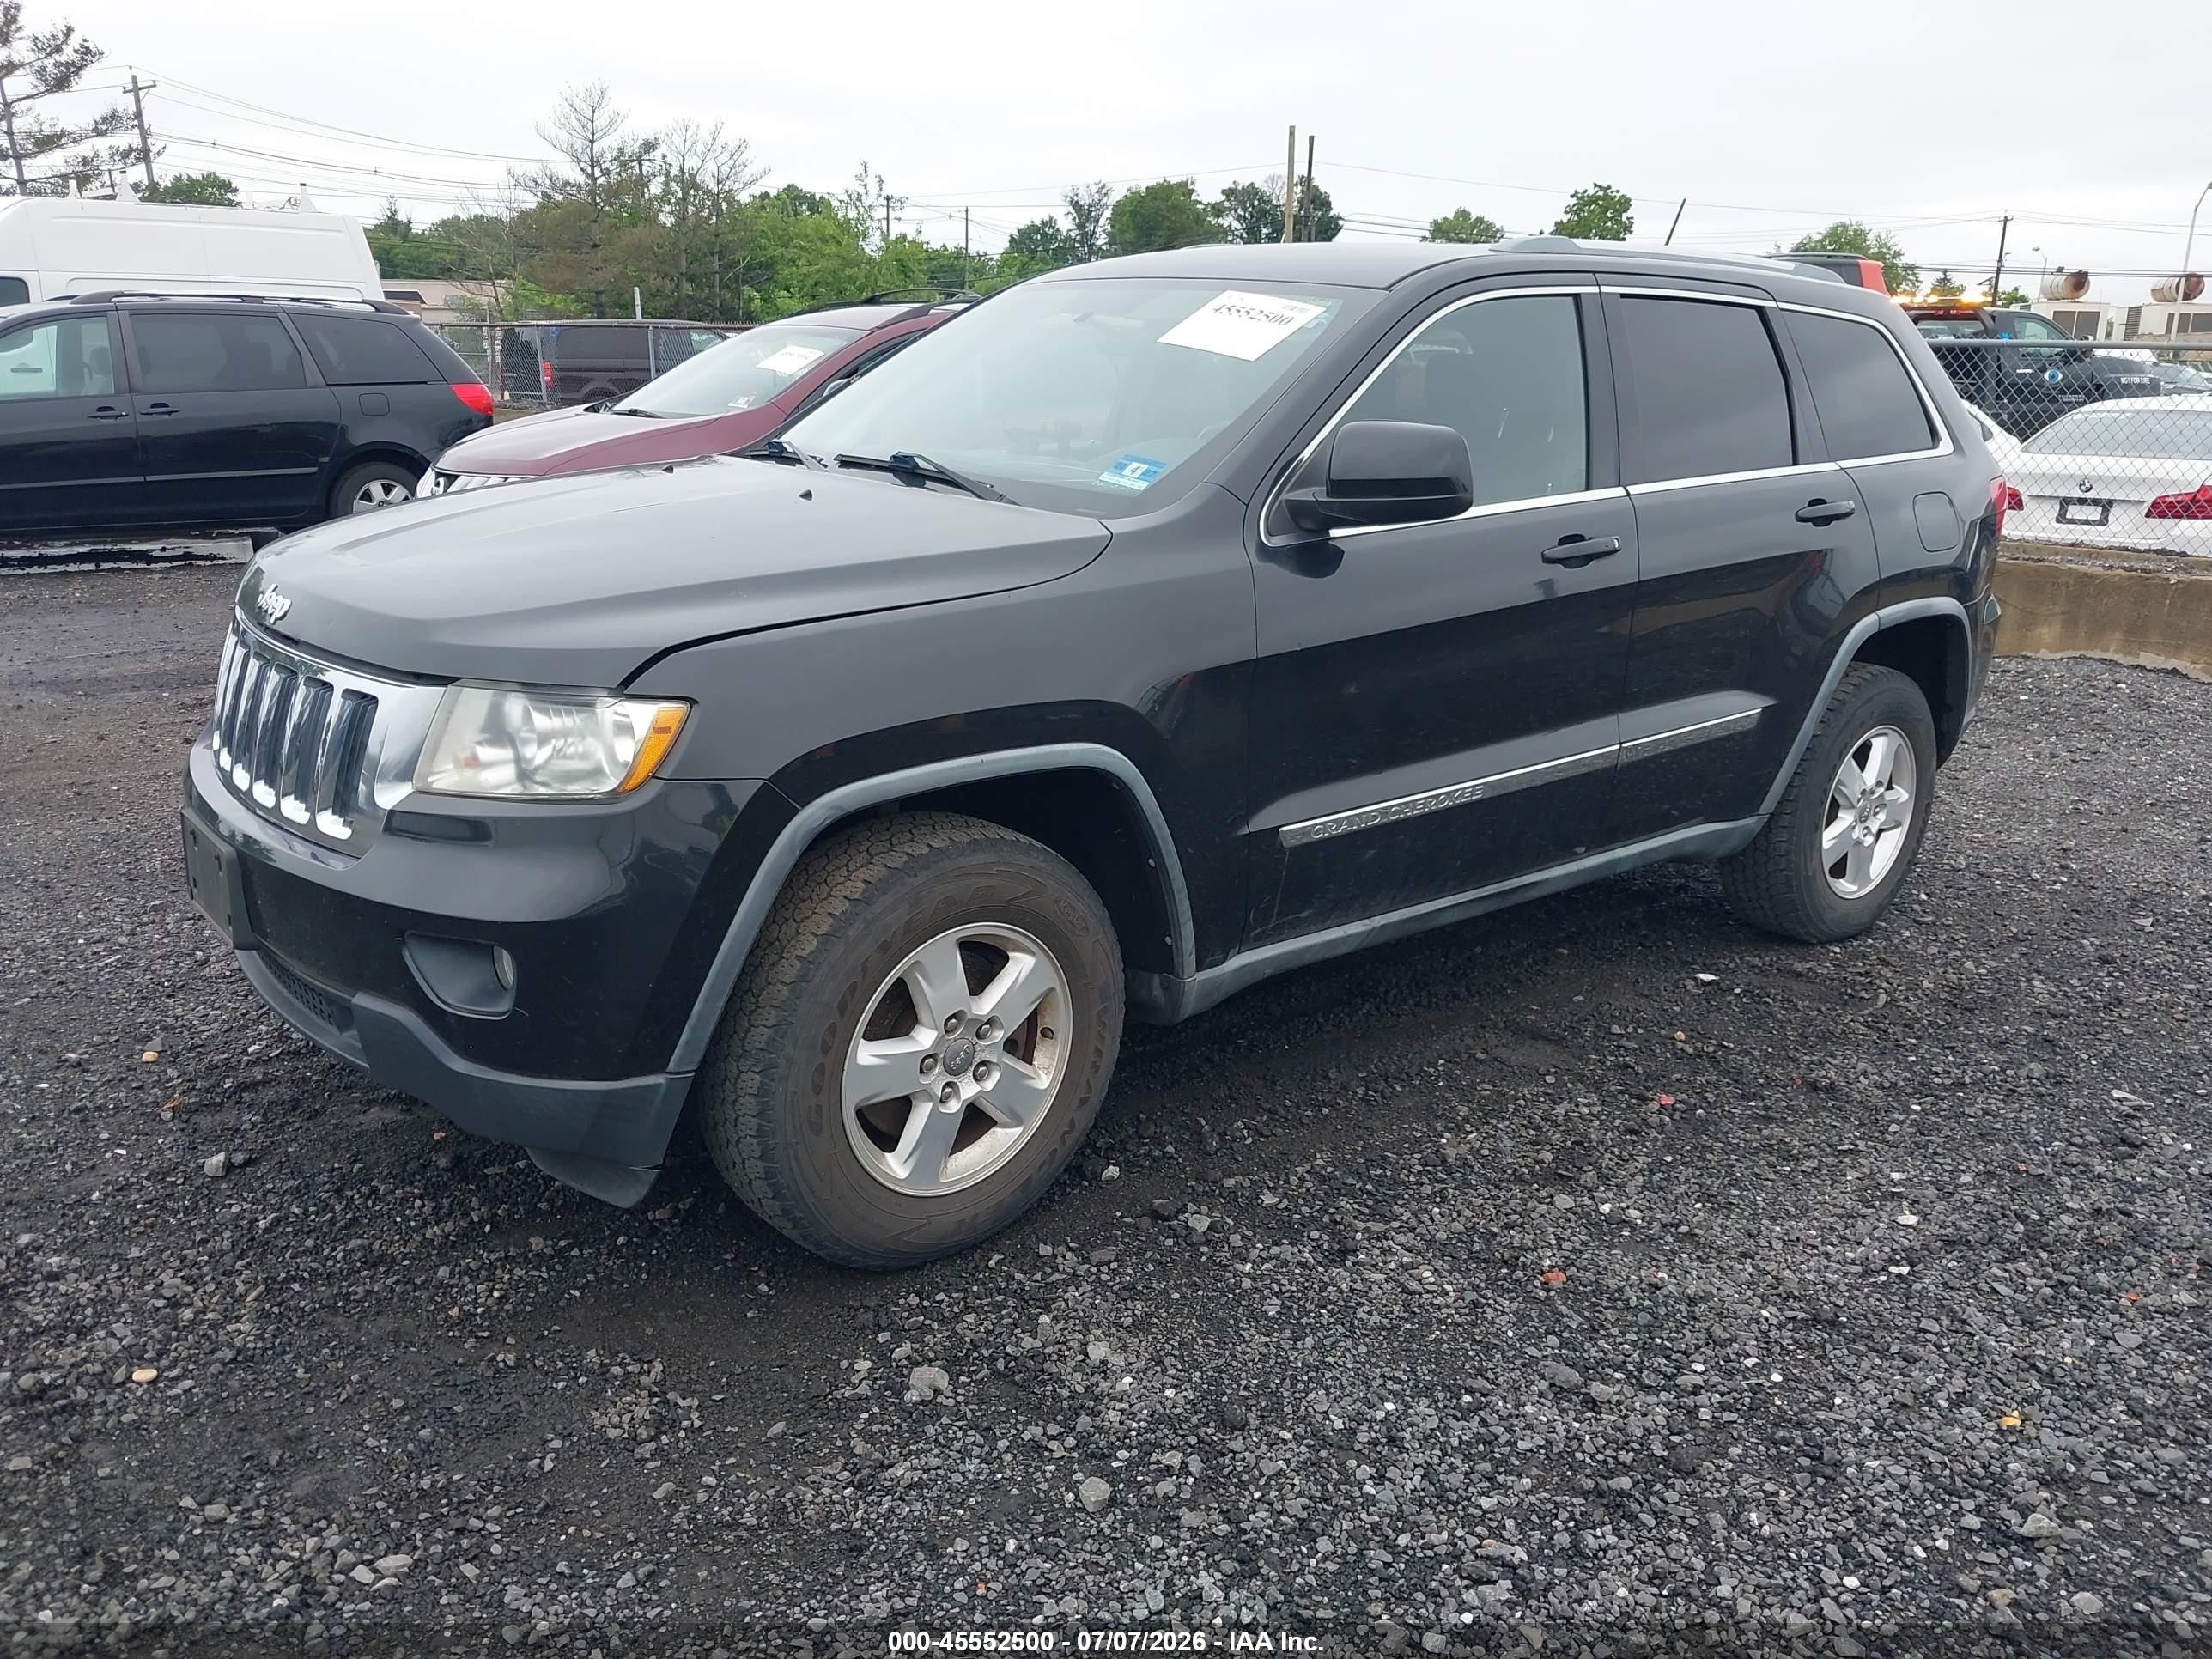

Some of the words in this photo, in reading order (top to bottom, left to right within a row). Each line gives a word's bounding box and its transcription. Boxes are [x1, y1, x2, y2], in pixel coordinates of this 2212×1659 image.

[1213, 303, 1295, 326] 45552500
[1129, 465, 1141, 475] 4
[257, 583, 292, 624] Jeep
[1310, 811, 1382, 839] GRAND
[1389, 785, 1484, 820] CHEROKEE
